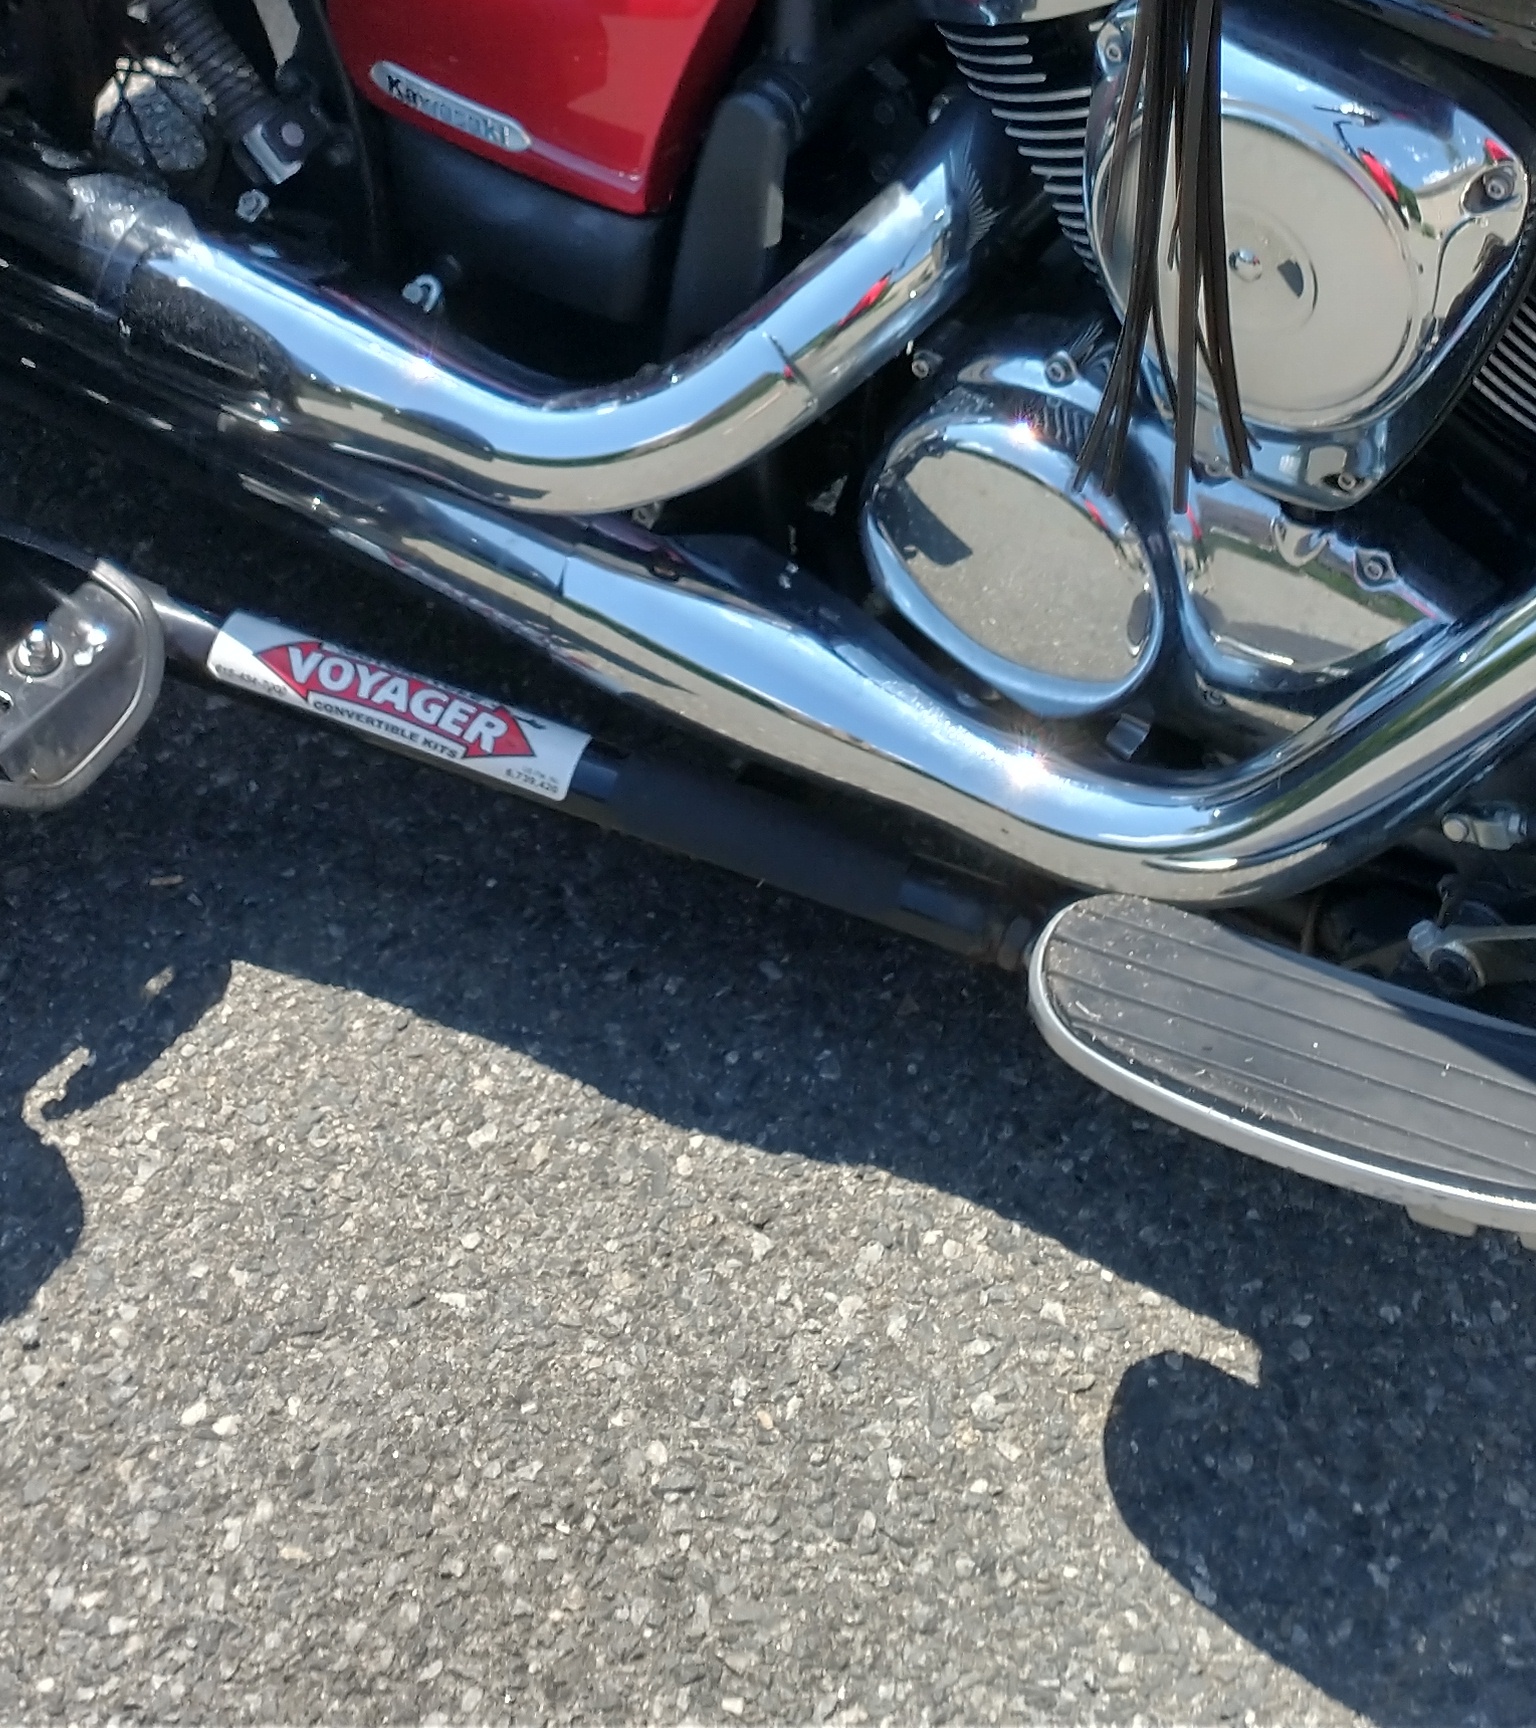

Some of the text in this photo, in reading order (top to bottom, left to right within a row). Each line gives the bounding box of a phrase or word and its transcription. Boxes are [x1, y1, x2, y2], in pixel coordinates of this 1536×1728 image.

[288, 645, 509, 754] VOYAGER
[313, 699, 459, 760] CONVERTIBLE KITS
